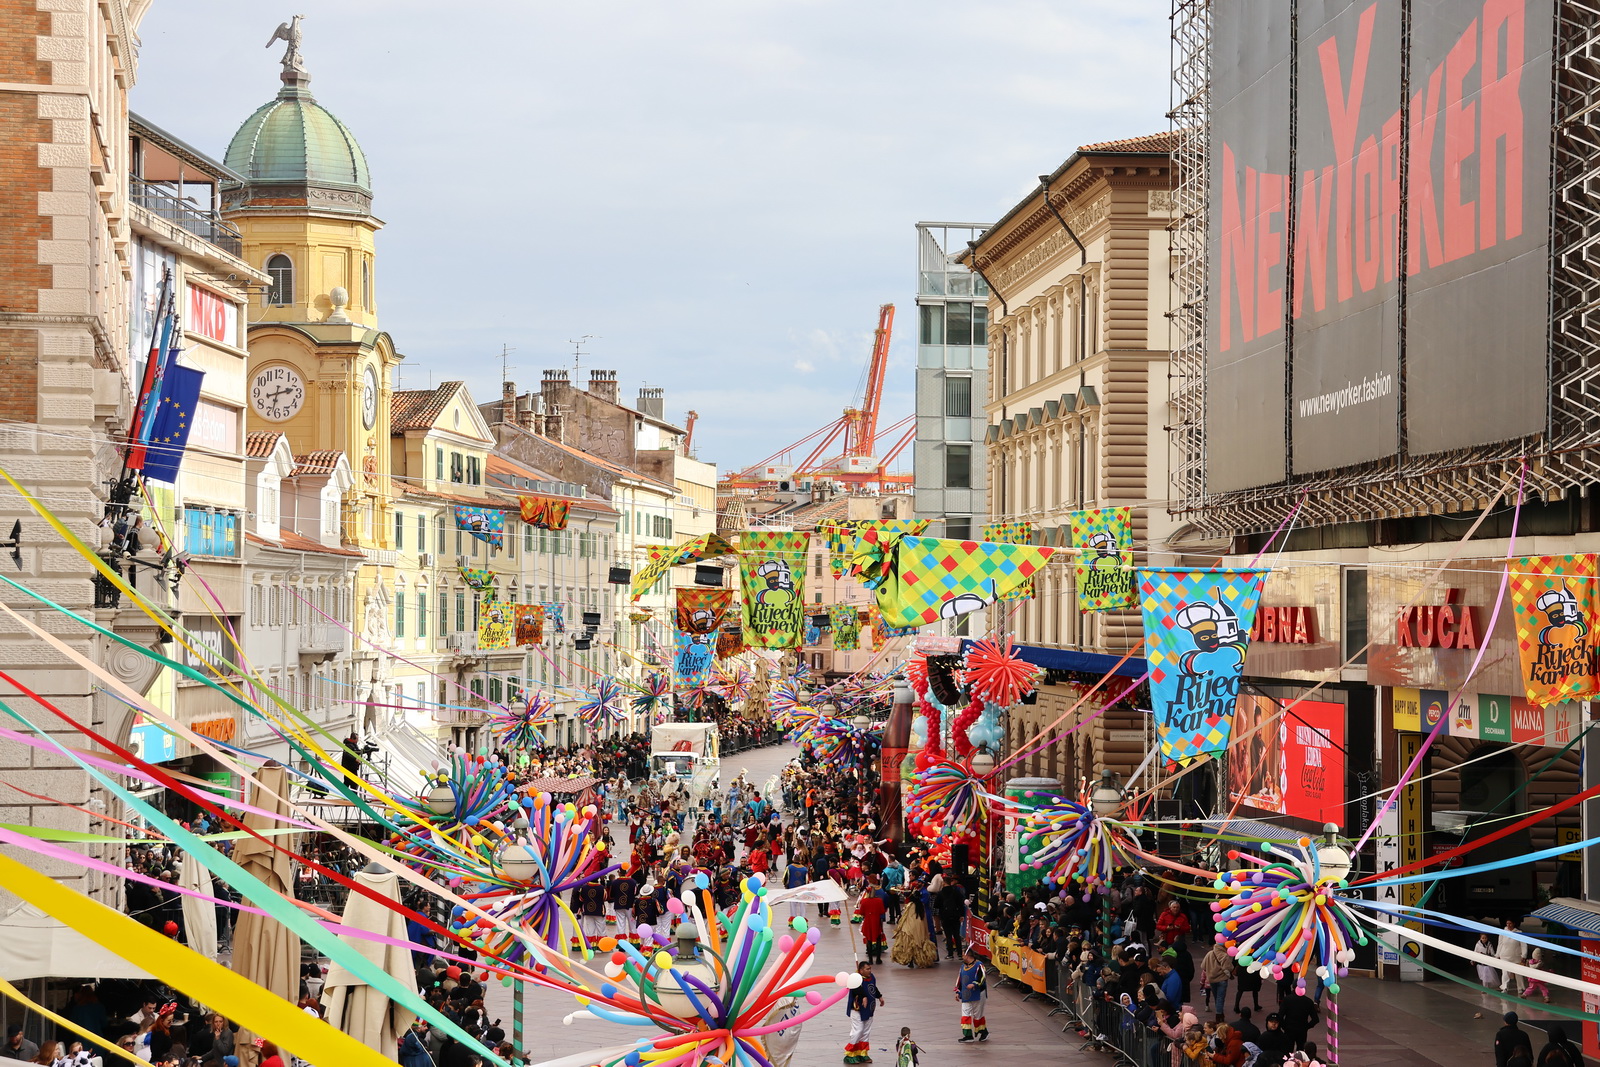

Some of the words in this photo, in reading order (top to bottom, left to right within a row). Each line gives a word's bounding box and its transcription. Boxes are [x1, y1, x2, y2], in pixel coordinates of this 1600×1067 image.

[191, 285, 226, 342] NKD
[265, 371, 273, 382] 11
[274, 369, 284, 380] 12
[286, 371, 291, 382] 1
[256, 376, 267, 387] 10
[291, 377, 298, 388] 2
[253, 387, 261, 398] 9
[295, 388, 302, 399] 3
[1299, 370, 1393, 418] www.newyorker.fashion
[256, 398, 264, 410] 8
[290, 398, 298, 409] 4
[265, 406, 273, 417] 7
[273, 407, 281, 419] 6
[282, 405, 290, 417] 5
[1397, 588, 1479, 649] KUĆA
[1458, 698, 1471, 719] dm
[1514, 709, 1543, 732] MANA
[1484, 727, 1506, 736] DEICHMANN
[1406, 741, 1416, 811] HPY
